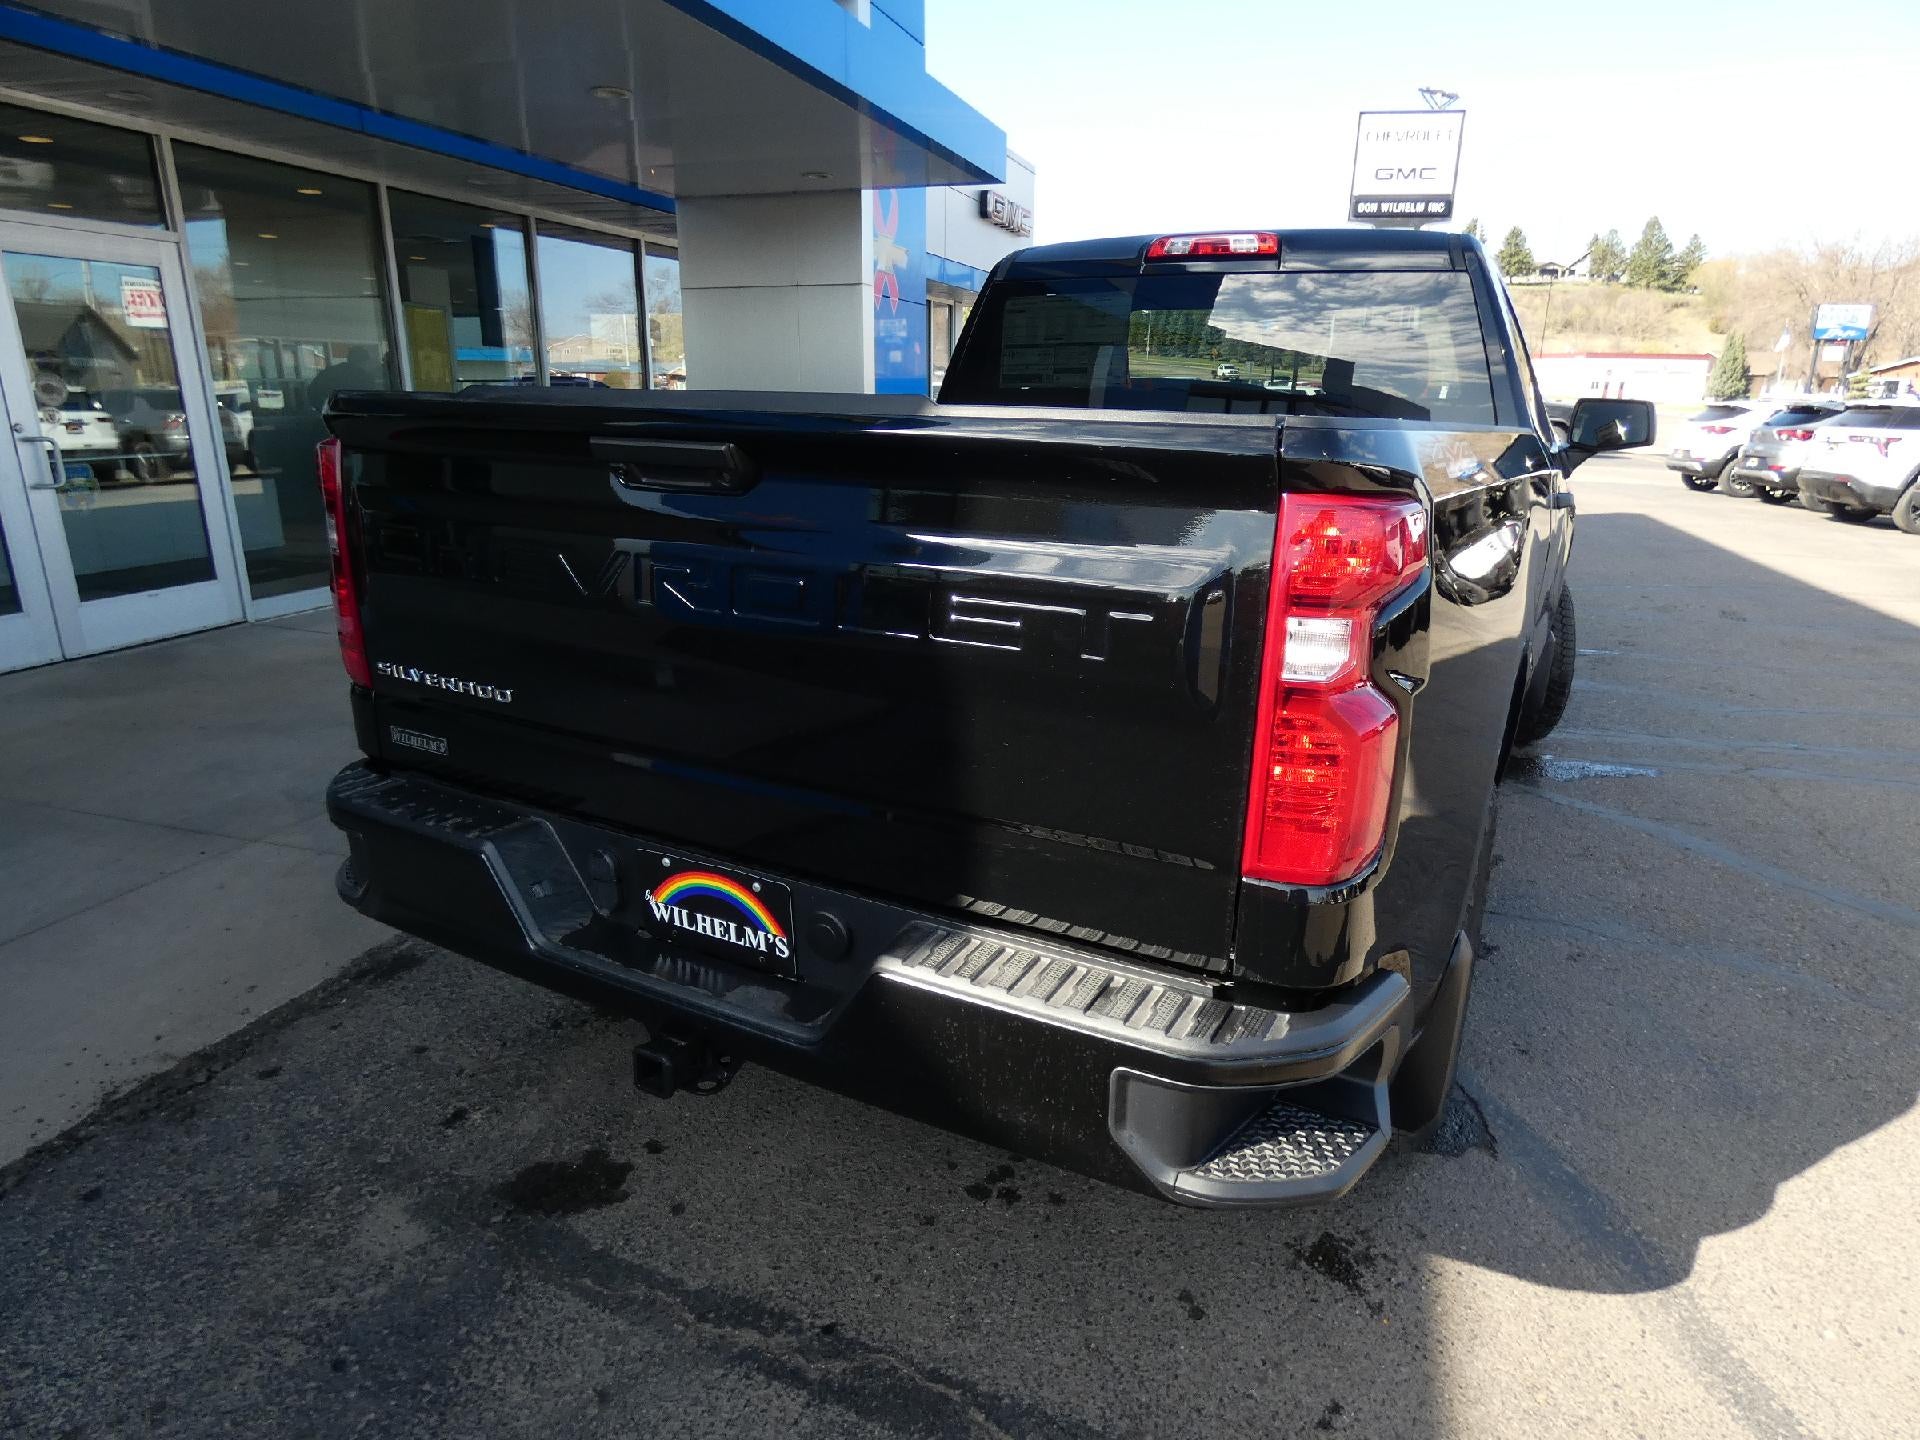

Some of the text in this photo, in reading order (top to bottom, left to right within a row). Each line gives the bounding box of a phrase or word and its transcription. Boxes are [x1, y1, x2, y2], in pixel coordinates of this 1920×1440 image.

[1375, 167, 1437, 180] GMC
[983, 189, 1032, 238] GMC
[1358, 202, 1378, 213] DON
[1381, 202, 1425, 213] WILHELM
[376, 661, 513, 703] SILVERADO
[393, 728, 446, 753] WILHELM'S
[649, 900, 790, 959] WILHELM'S
